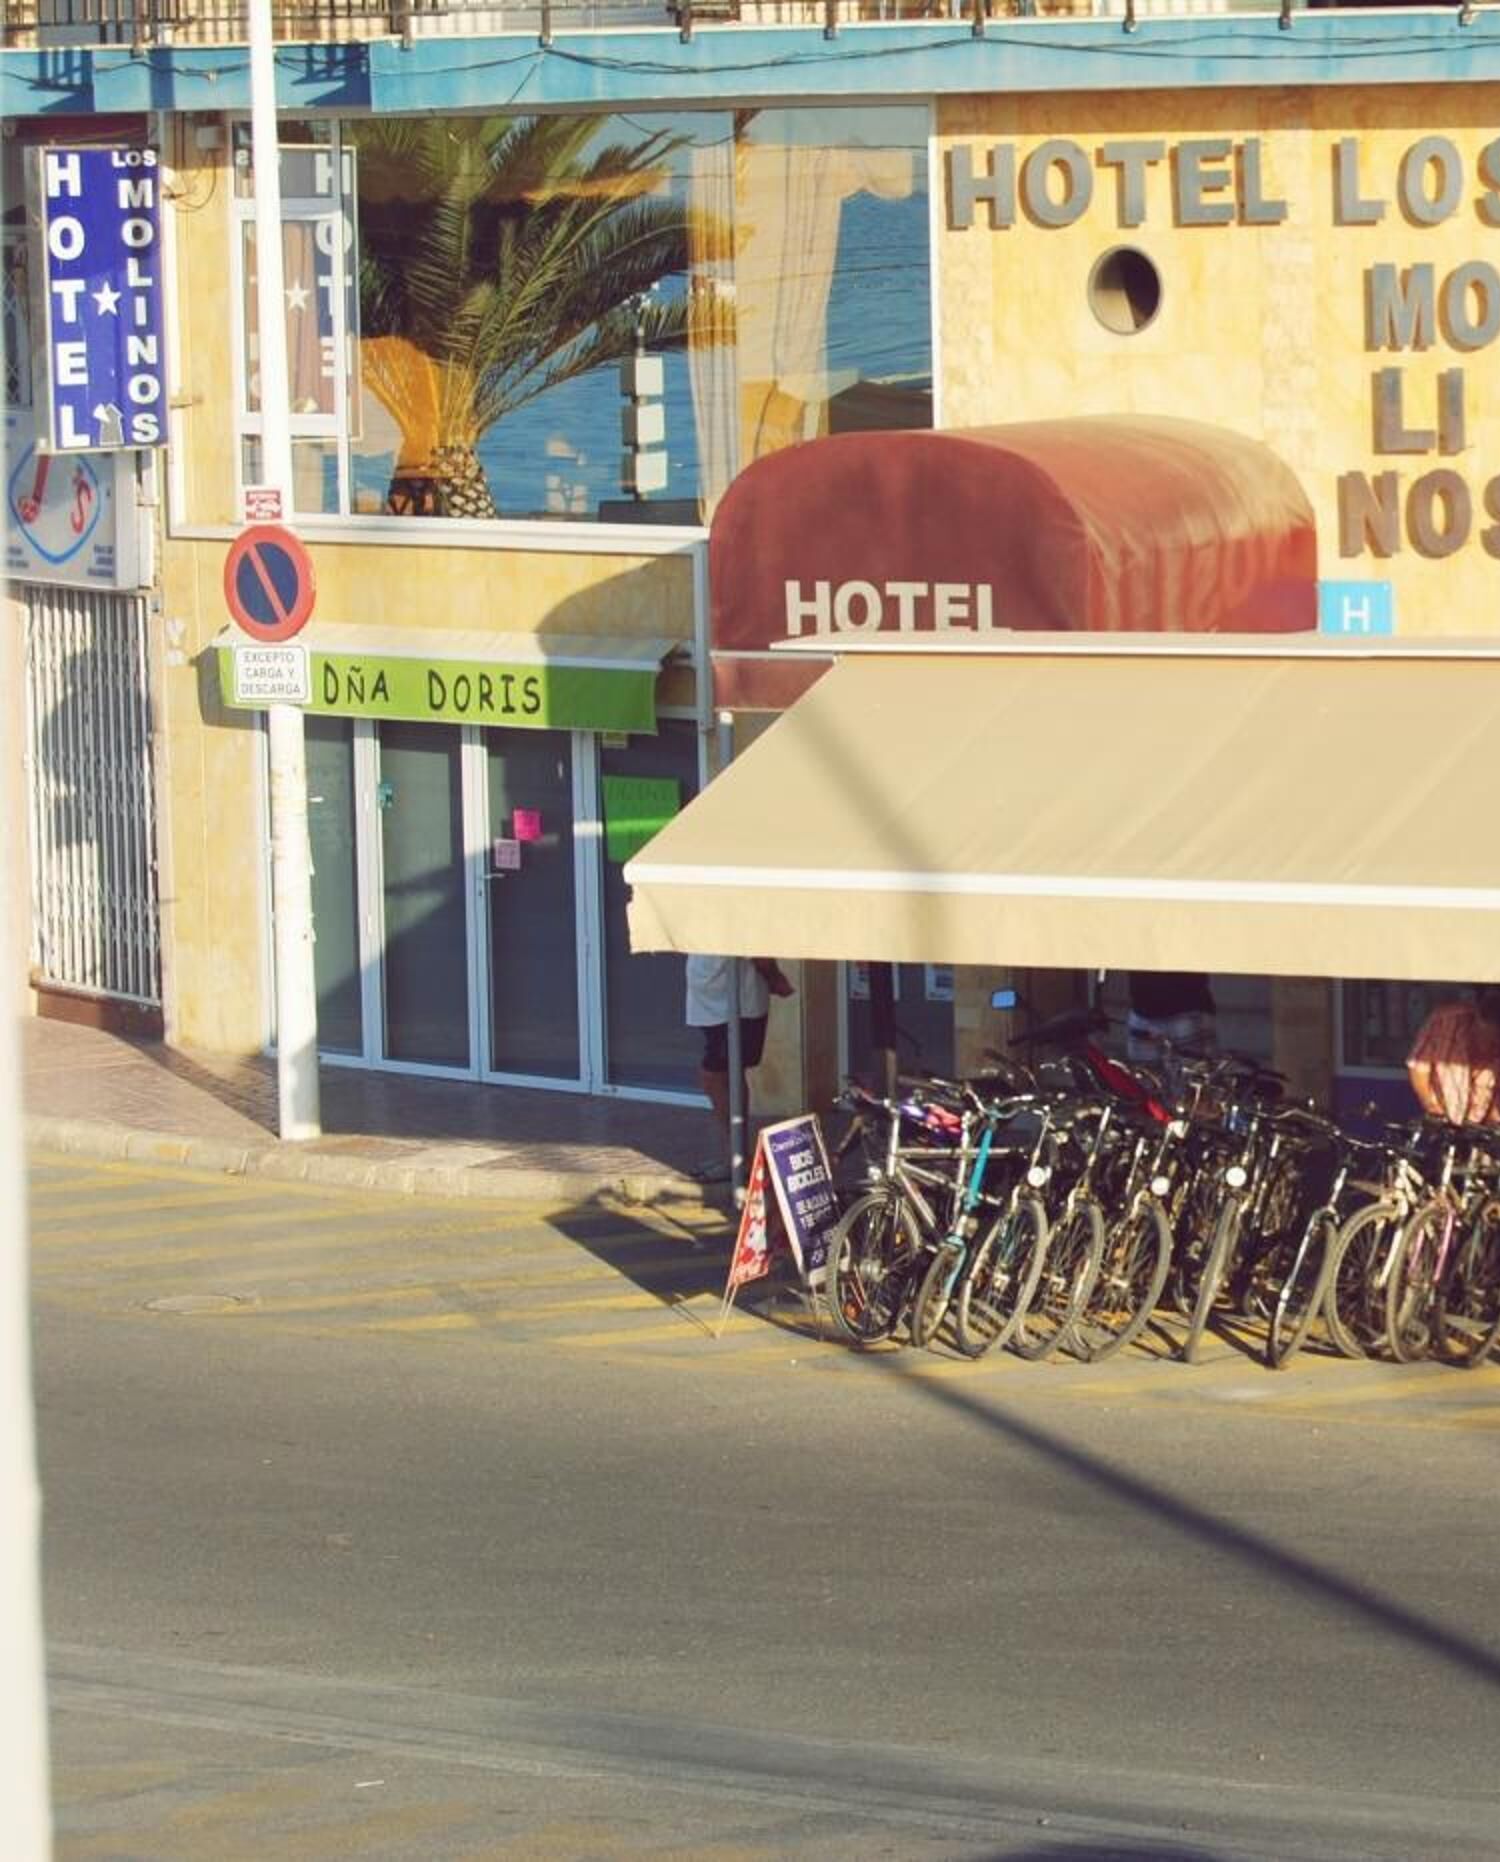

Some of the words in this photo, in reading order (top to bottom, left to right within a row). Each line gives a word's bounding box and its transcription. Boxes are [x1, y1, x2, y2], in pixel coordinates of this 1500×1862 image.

[111, 151, 157, 167] LOS
[945, 137, 1288, 231] HOTEL
[47, 153, 91, 448] HOTEL
[117, 178, 161, 443] MOLINOS
[1372, 367, 1466, 456] LI
[785, 579, 1013, 635] HOTEL
[1342, 594, 1371, 631] H
[243, 651, 295, 663] EXCEPTO
[244, 667, 283, 679] CARGA
[287, 667, 295, 679] Y
[240, 683, 301, 695] DESCARGA
[323, 660, 390, 705] DÑA
[427, 668, 541, 714] DORIS
